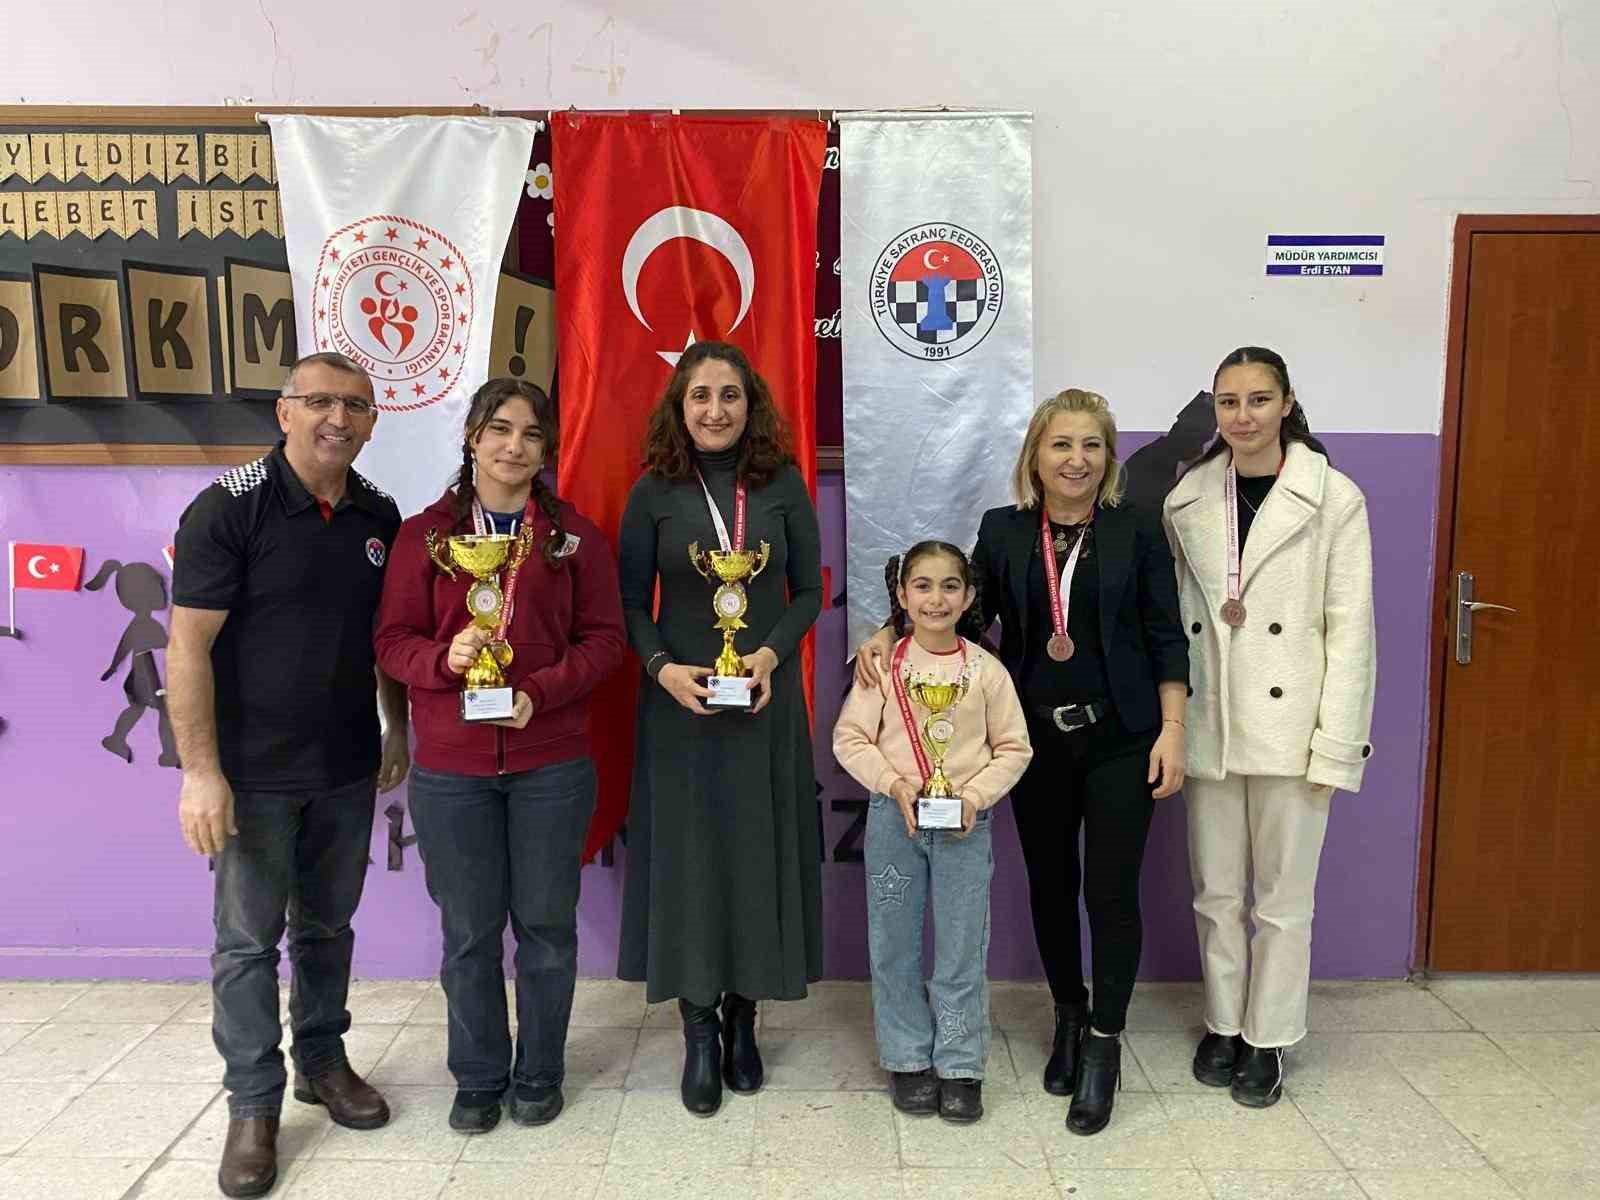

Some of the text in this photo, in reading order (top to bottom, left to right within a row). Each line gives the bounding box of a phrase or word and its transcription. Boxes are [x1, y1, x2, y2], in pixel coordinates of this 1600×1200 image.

[5, 142, 190, 166] YILDIZ
[2, 199, 148, 224] LEBET
[372, 251, 427, 276] GENÇLİK
[1275, 250, 1378, 261] MÜDÜR YARDIMCISI
[425, 269, 439, 287] VE
[874, 259, 893, 316] TÜRKİYE
[889, 228, 947, 259] SATRANÇ
[950, 230, 1000, 312] FEDERASYONU
[1300, 265, 1350, 275] Erdi EYAN
[331, 253, 370, 329] CUMHURİYETİ
[332, 331, 376, 372] TÜRKİYE
[923, 346, 951, 357] 1991
